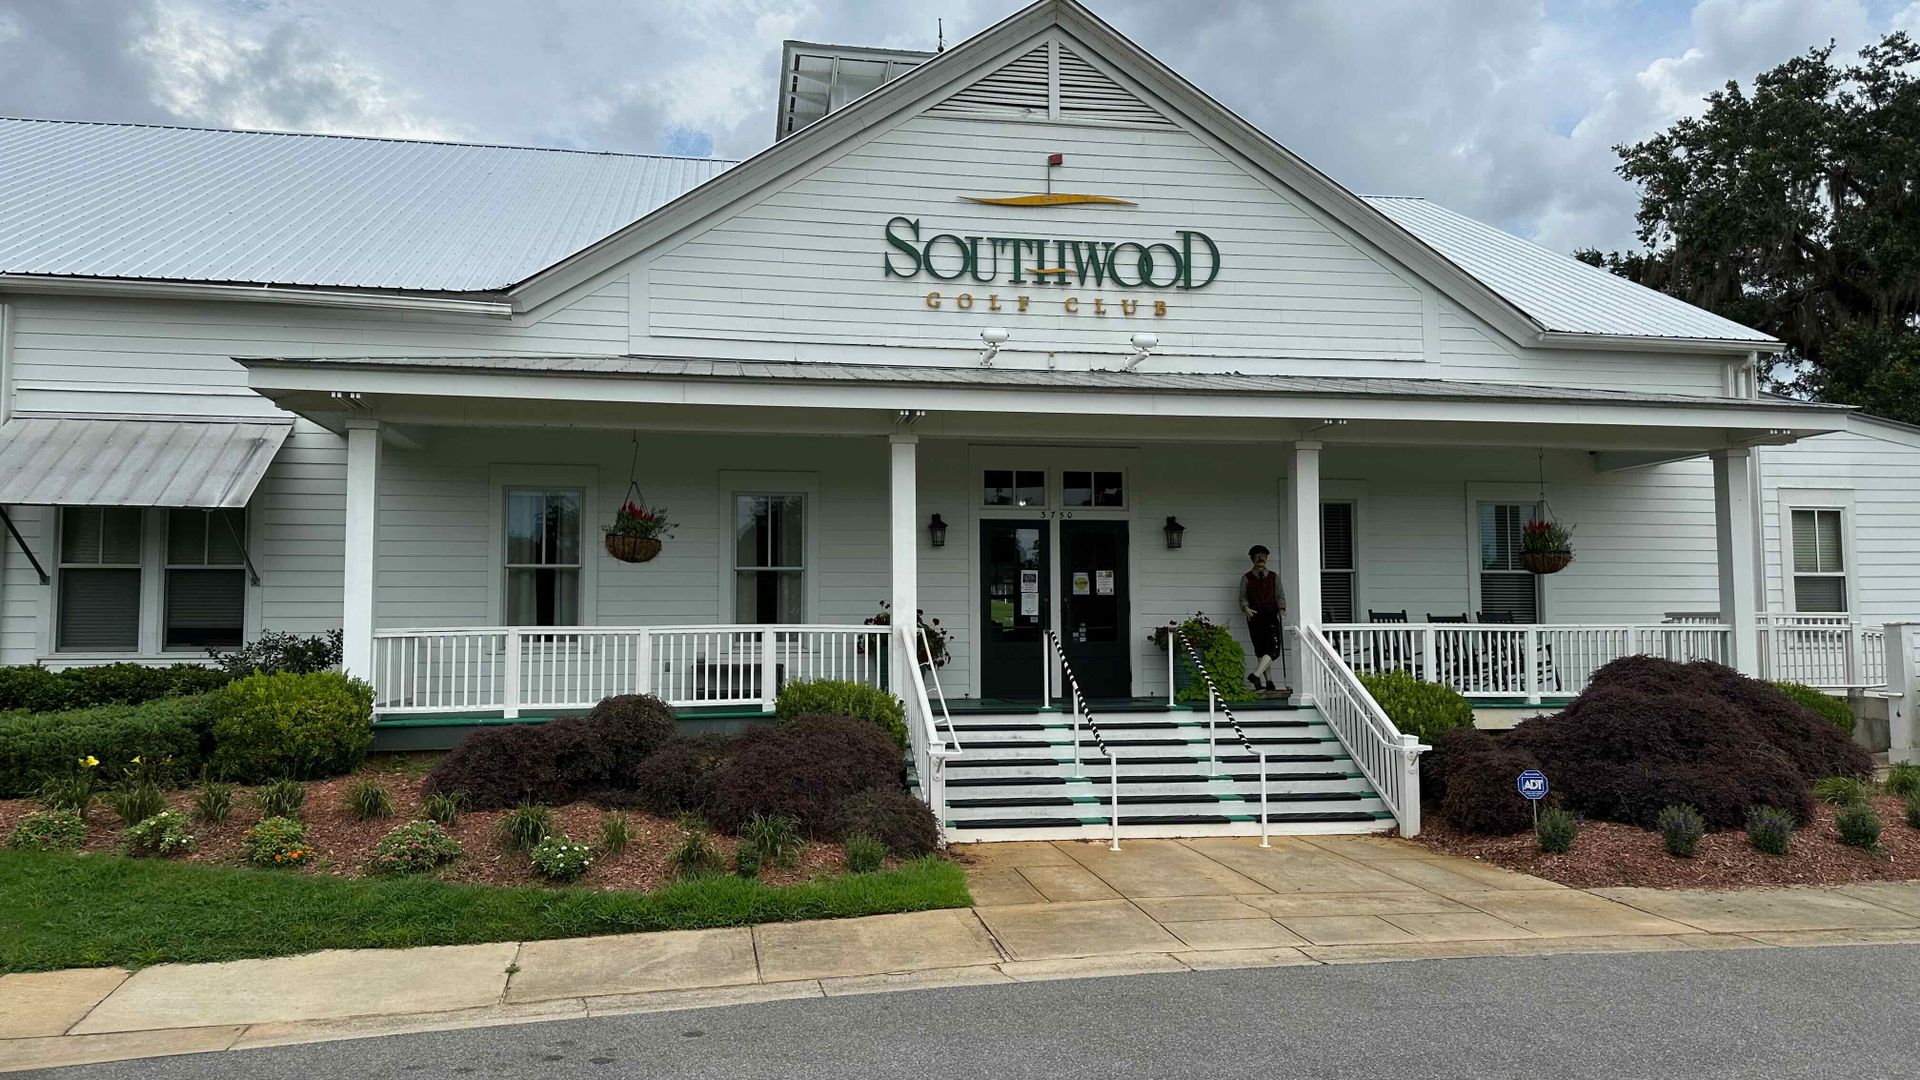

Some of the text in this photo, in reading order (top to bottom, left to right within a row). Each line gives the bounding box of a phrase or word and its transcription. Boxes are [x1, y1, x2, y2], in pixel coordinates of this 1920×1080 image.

[885, 216, 1221, 290] SOUTHWOOD
[926, 292, 1167, 317] GOLF CLUB
[1040, 511, 1073, 519] 3750
[1524, 779, 1543, 790] ADT
